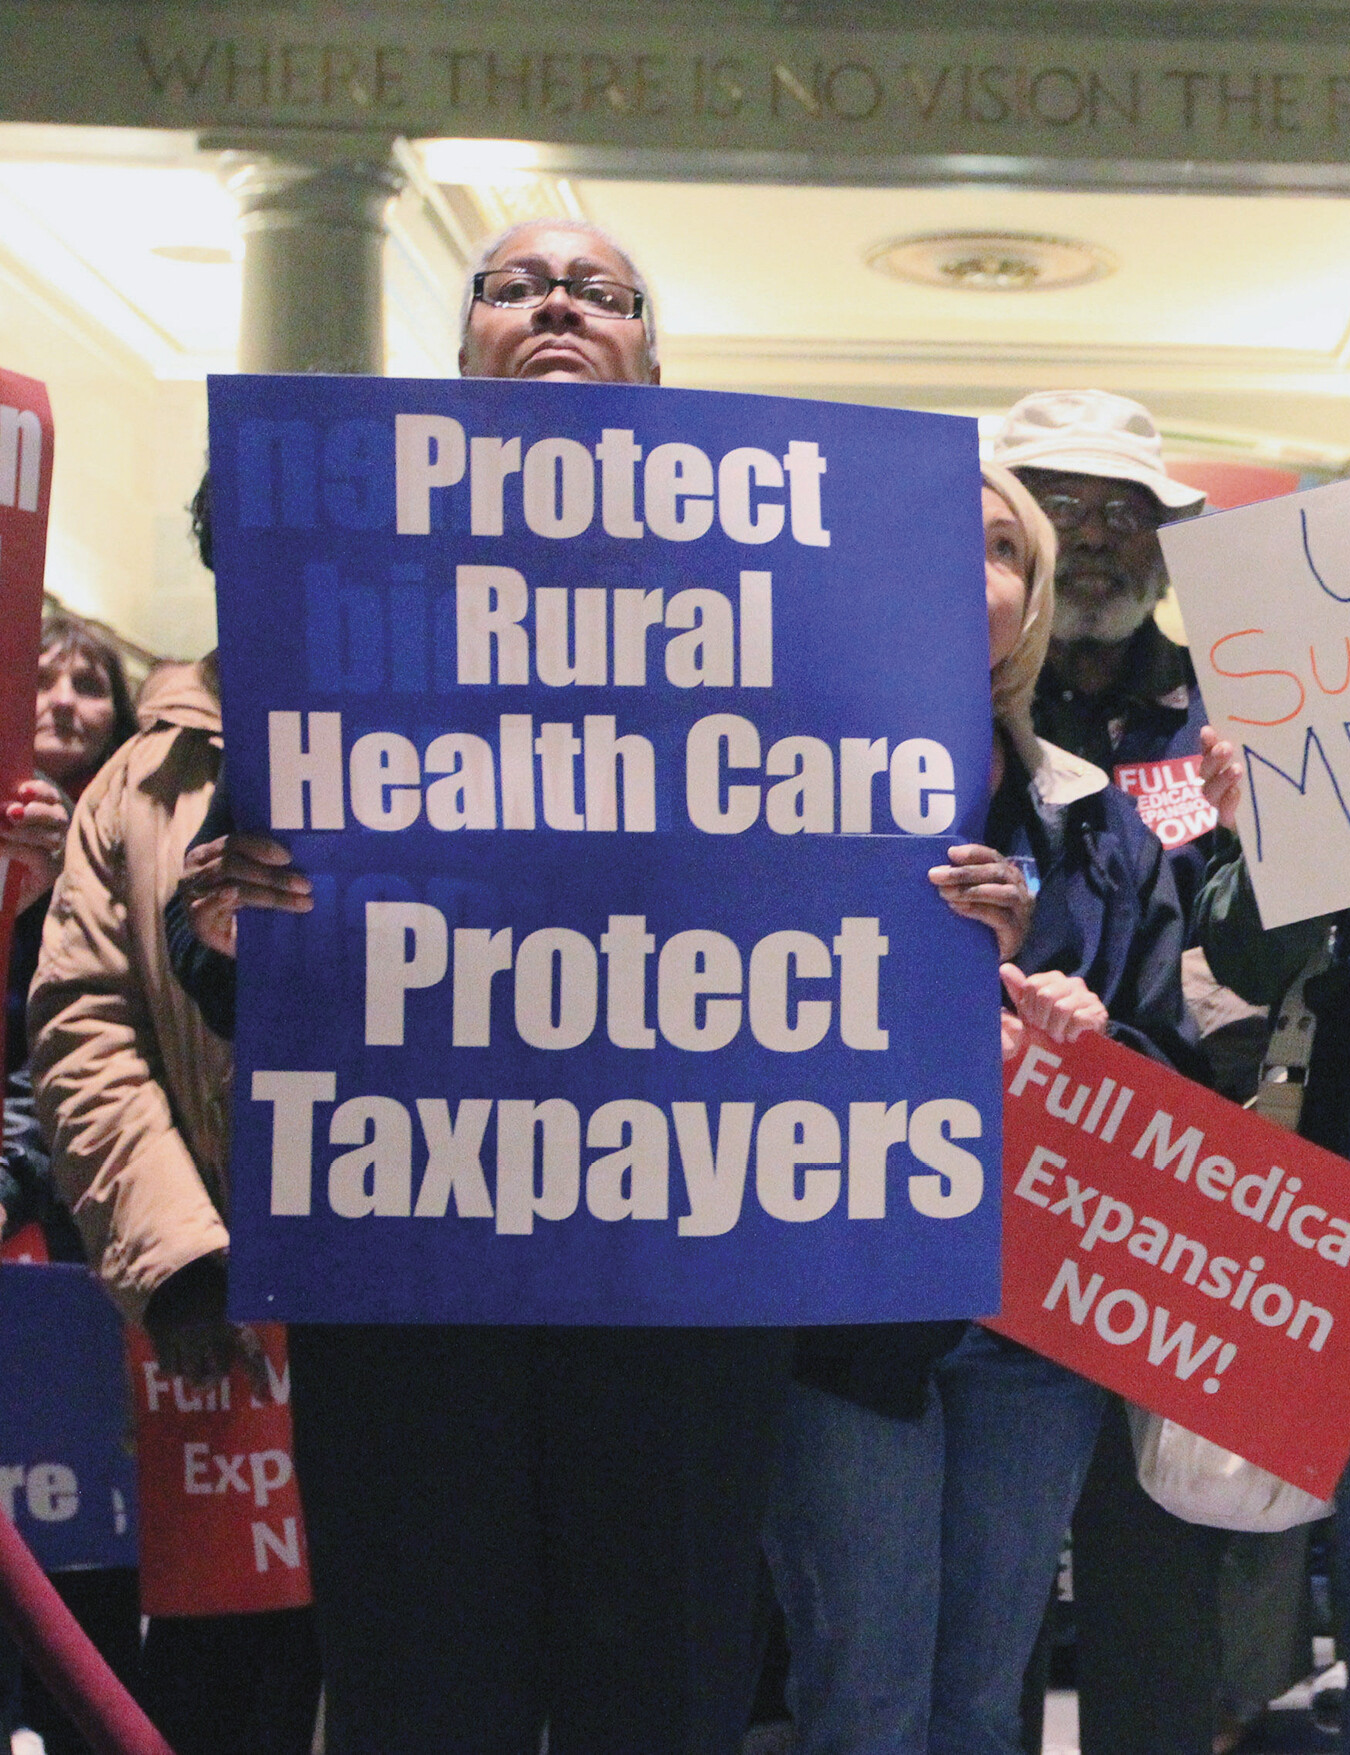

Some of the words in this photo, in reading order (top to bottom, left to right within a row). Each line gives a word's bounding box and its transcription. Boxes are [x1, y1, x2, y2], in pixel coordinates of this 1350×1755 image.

[134, 35, 410, 108] WHERE
[430, 47, 672, 117] THERE
[690, 54, 747, 120] IS
[770, 59, 884, 122] NO
[905, 63, 1140, 129] VISION
[1162, 69, 1306, 134] THE
[395, 413, 831, 548] Protect
[455, 564, 774, 689] Rural
[267, 710, 657, 833] Health
[686, 712, 957, 836] Care
[1119, 761, 1206, 794] FULL
[364, 900, 889, 1053] Protect
[250, 1069, 985, 1238] Taxpayers
[1007, 1045, 1136, 1144] Full
[1013, 1145, 1334, 1353] Expansion
[1041, 1258, 1238, 1395] NOW!
